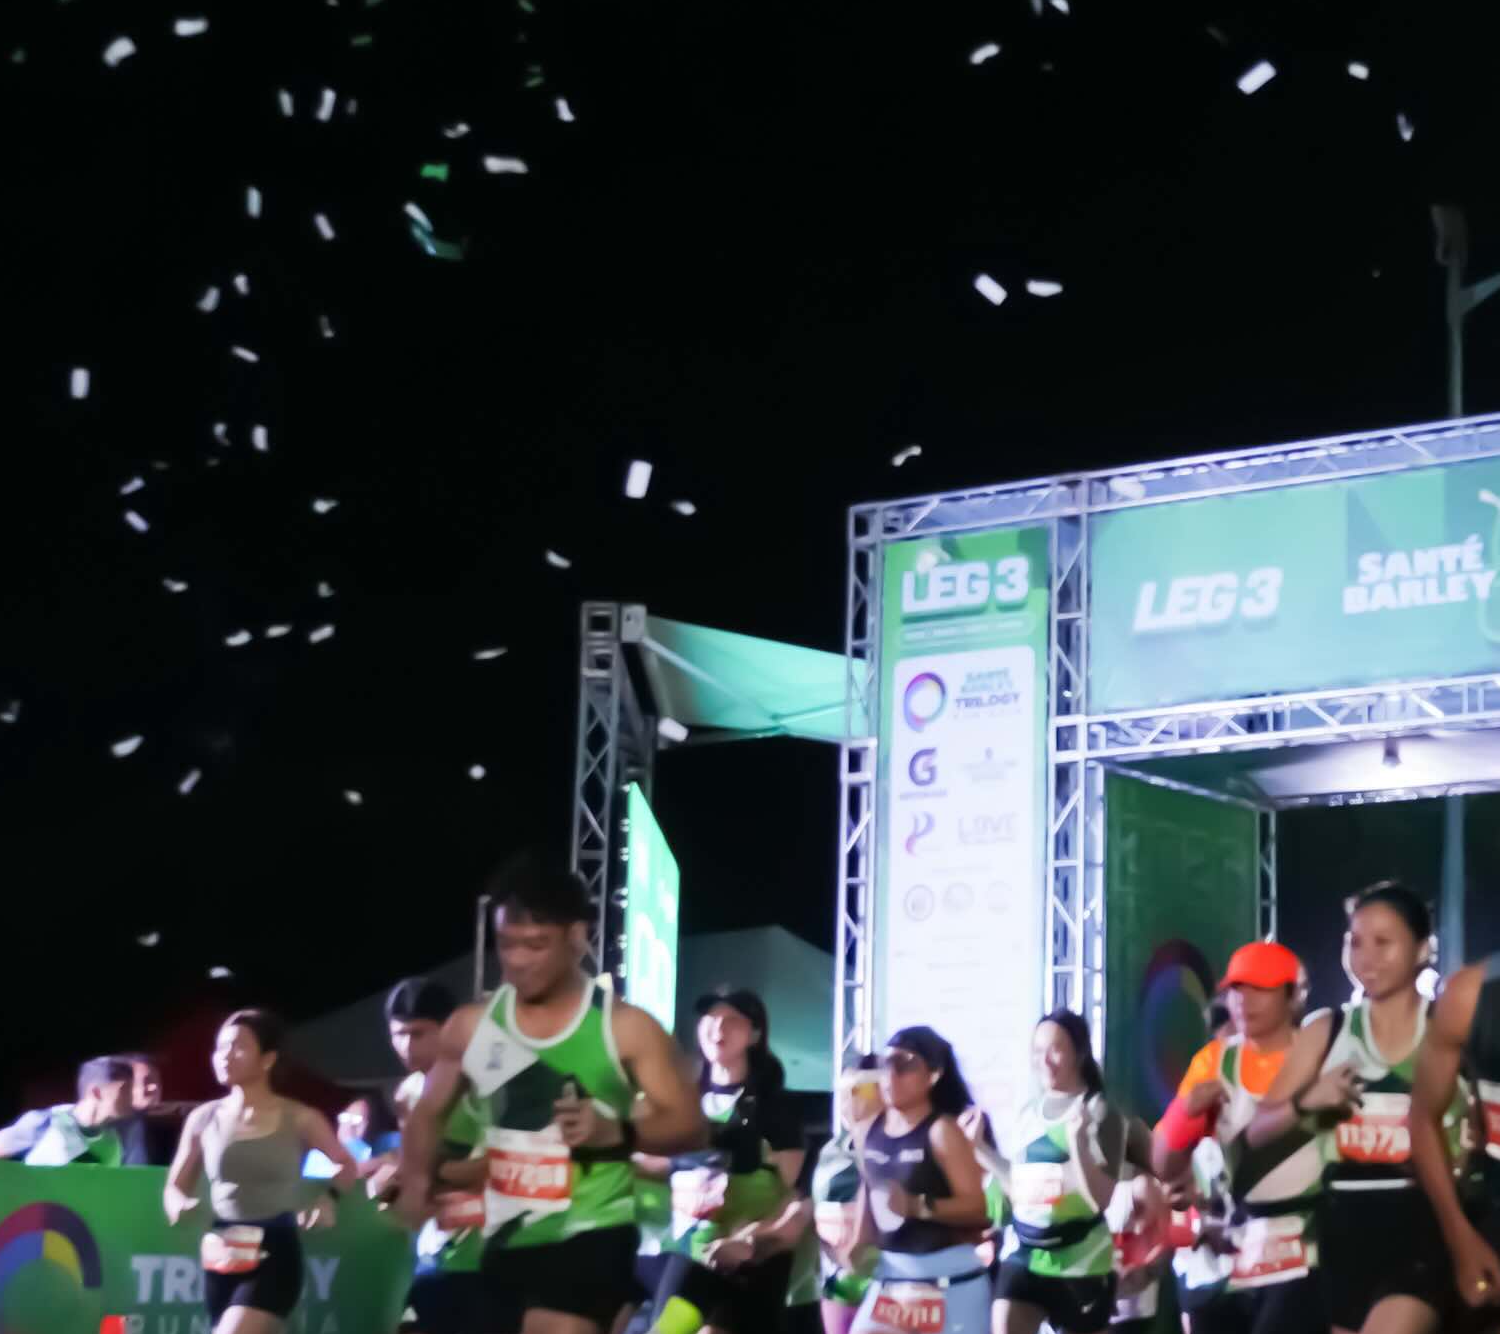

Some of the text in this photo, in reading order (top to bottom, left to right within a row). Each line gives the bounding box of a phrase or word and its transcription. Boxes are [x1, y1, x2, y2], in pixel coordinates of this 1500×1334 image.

[902, 555, 1030, 615] LEG 3
[1357, 534, 1486, 585] SANTÉ
[1133, 567, 1284, 632] LEG 3
[1342, 569, 1499, 615] BARLEY
